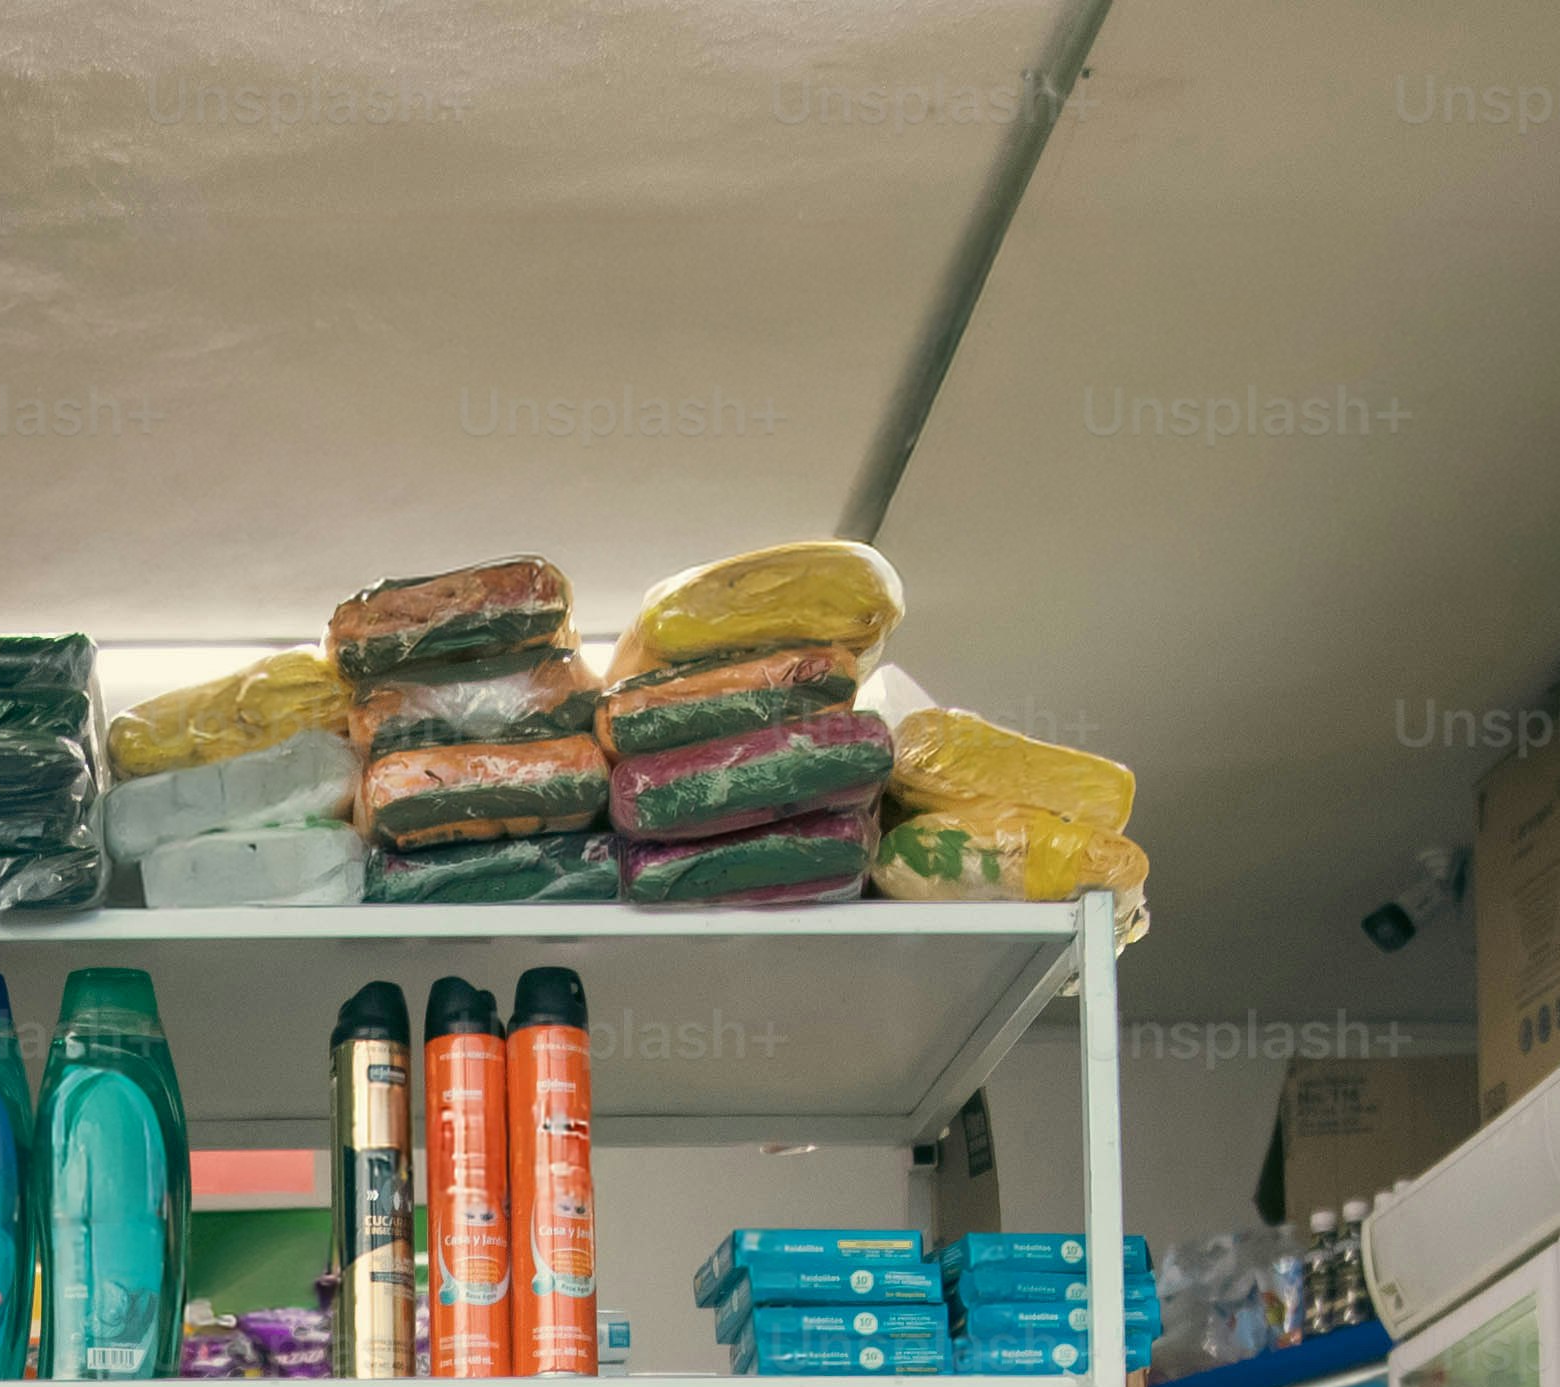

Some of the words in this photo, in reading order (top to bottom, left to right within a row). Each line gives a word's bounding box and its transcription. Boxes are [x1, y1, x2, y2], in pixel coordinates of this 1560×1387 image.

[1012, 1244, 1052, 1253] Raidolitos
[800, 1273, 840, 1282] Raidolitos
[1017, 1283, 1056, 1295] Raidolitos
[1018, 1312, 1059, 1321] Raidolitos
[809, 1351, 849, 1359] Raidolitos
[1001, 1349, 1043, 1359] Raidolitos
